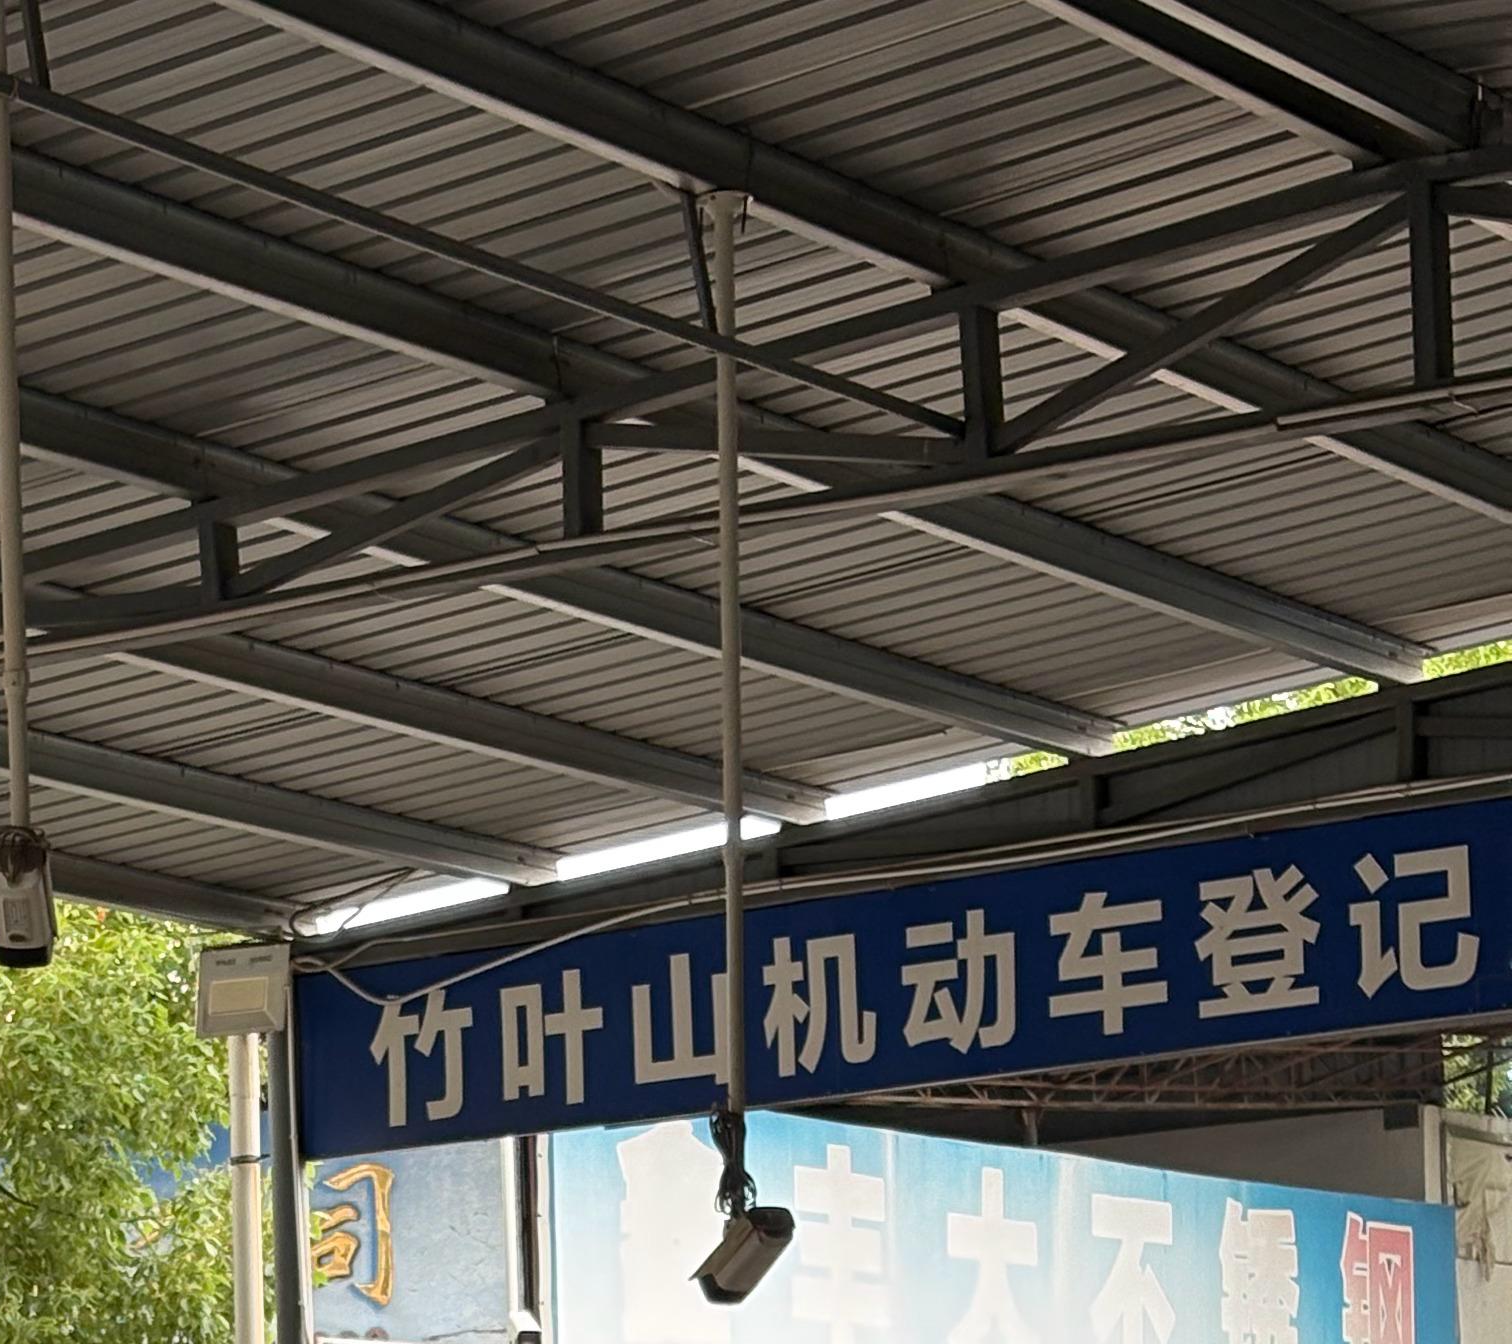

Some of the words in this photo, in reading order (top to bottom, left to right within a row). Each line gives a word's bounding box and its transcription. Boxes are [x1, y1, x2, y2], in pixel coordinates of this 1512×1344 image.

[369, 845, 1480, 1127] 竹叶山机动车登记
